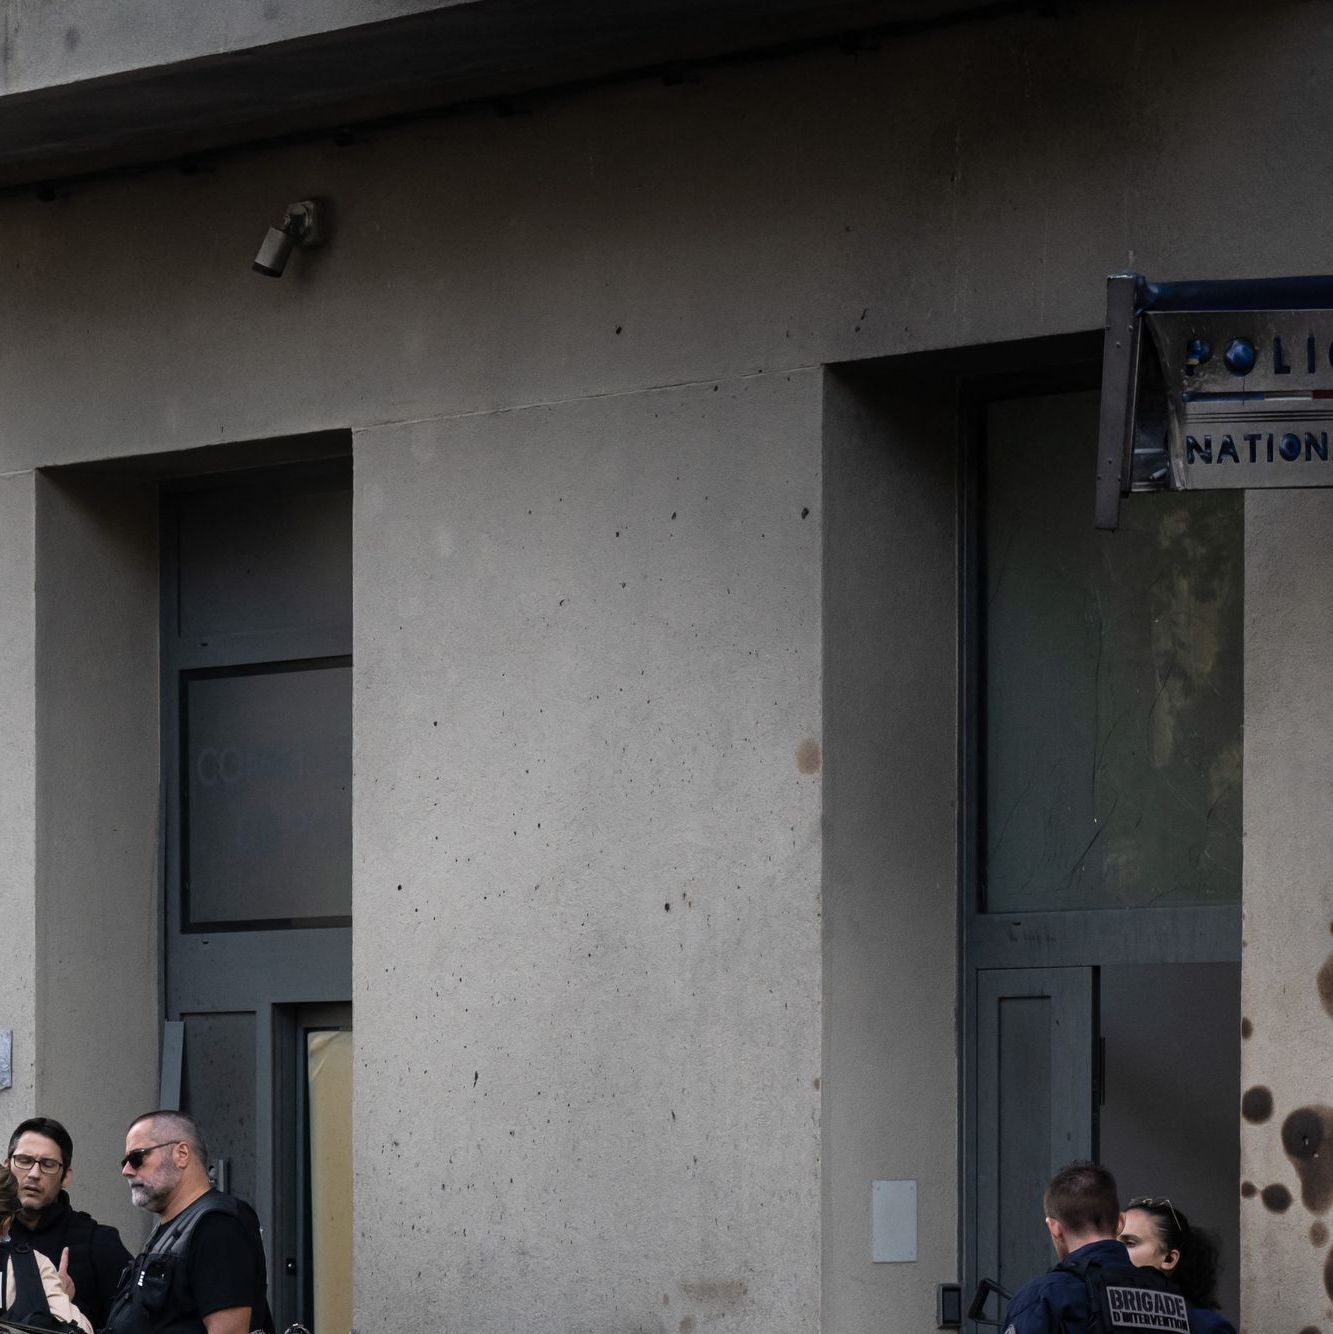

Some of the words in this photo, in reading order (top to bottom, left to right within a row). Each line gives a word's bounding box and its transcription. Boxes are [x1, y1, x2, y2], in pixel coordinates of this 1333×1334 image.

[1185, 336, 1333, 377] POLI
[1186, 431, 1333, 464] NATION
[1109, 1289, 1186, 1319] BRIGADE
[1112, 1310, 1189, 1332] D'INTERVENTION
